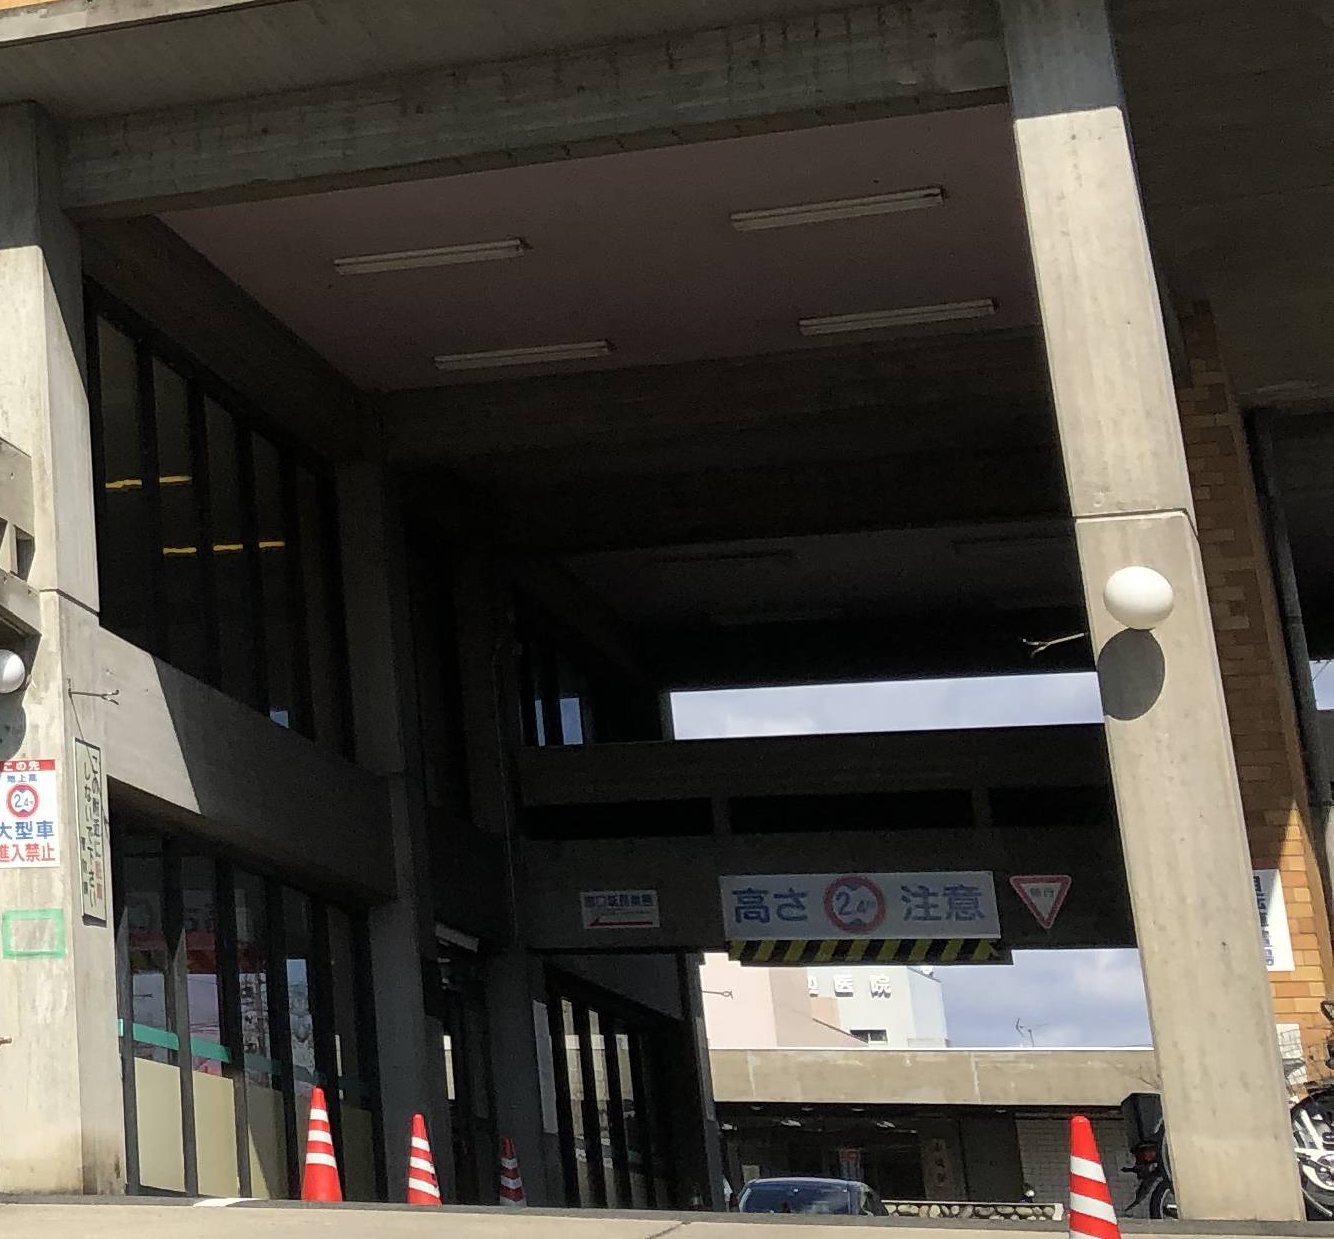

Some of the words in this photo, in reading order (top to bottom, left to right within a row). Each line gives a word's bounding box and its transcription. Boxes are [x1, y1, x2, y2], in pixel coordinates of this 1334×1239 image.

[3, 761, 40, 771] この先
[731, 887, 808, 923] 高さ
[900, 883, 986, 922] 注意
